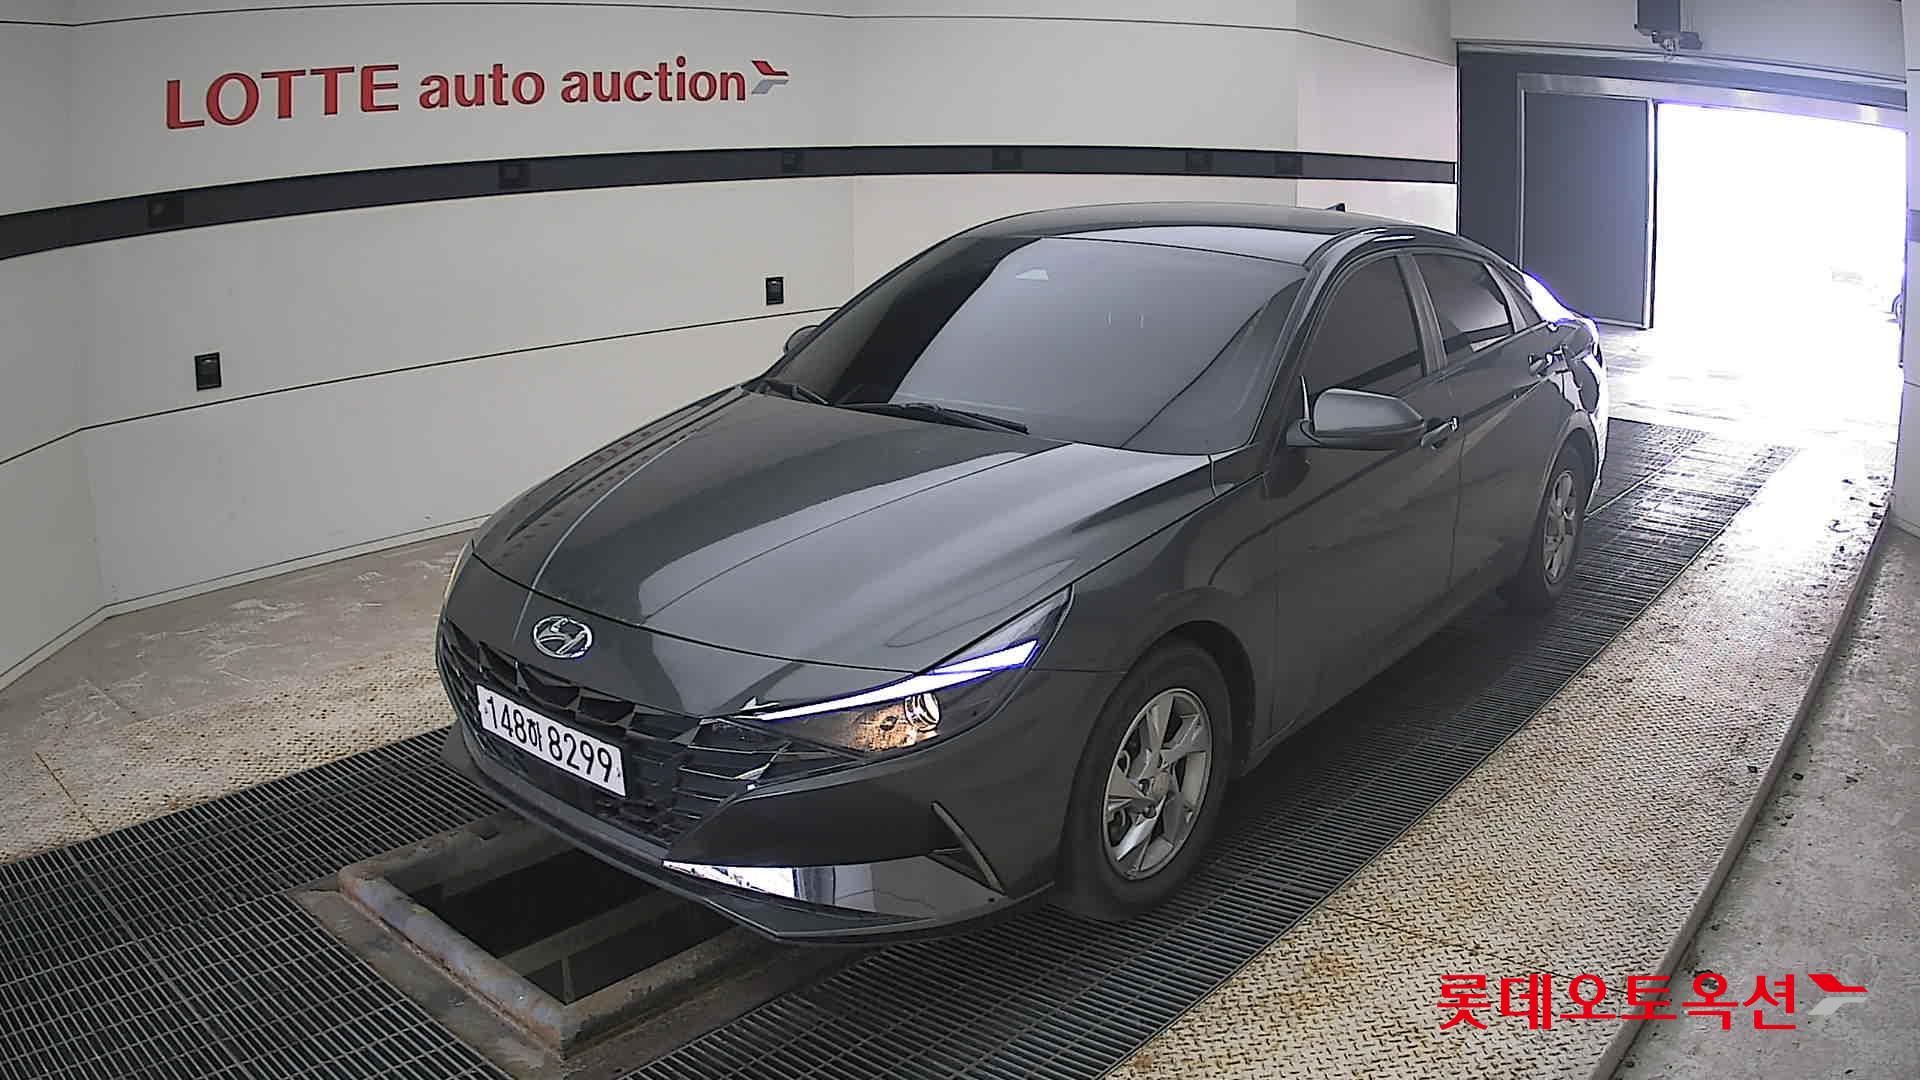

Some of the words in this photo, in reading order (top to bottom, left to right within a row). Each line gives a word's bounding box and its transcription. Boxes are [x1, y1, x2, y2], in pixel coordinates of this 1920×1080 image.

[166, 64, 399, 130] LOTTE
[419, 63, 545, 109] auto
[561, 56, 746, 102] auction
[486, 696, 543, 752] 148하
[547, 725, 613, 783] 8299
